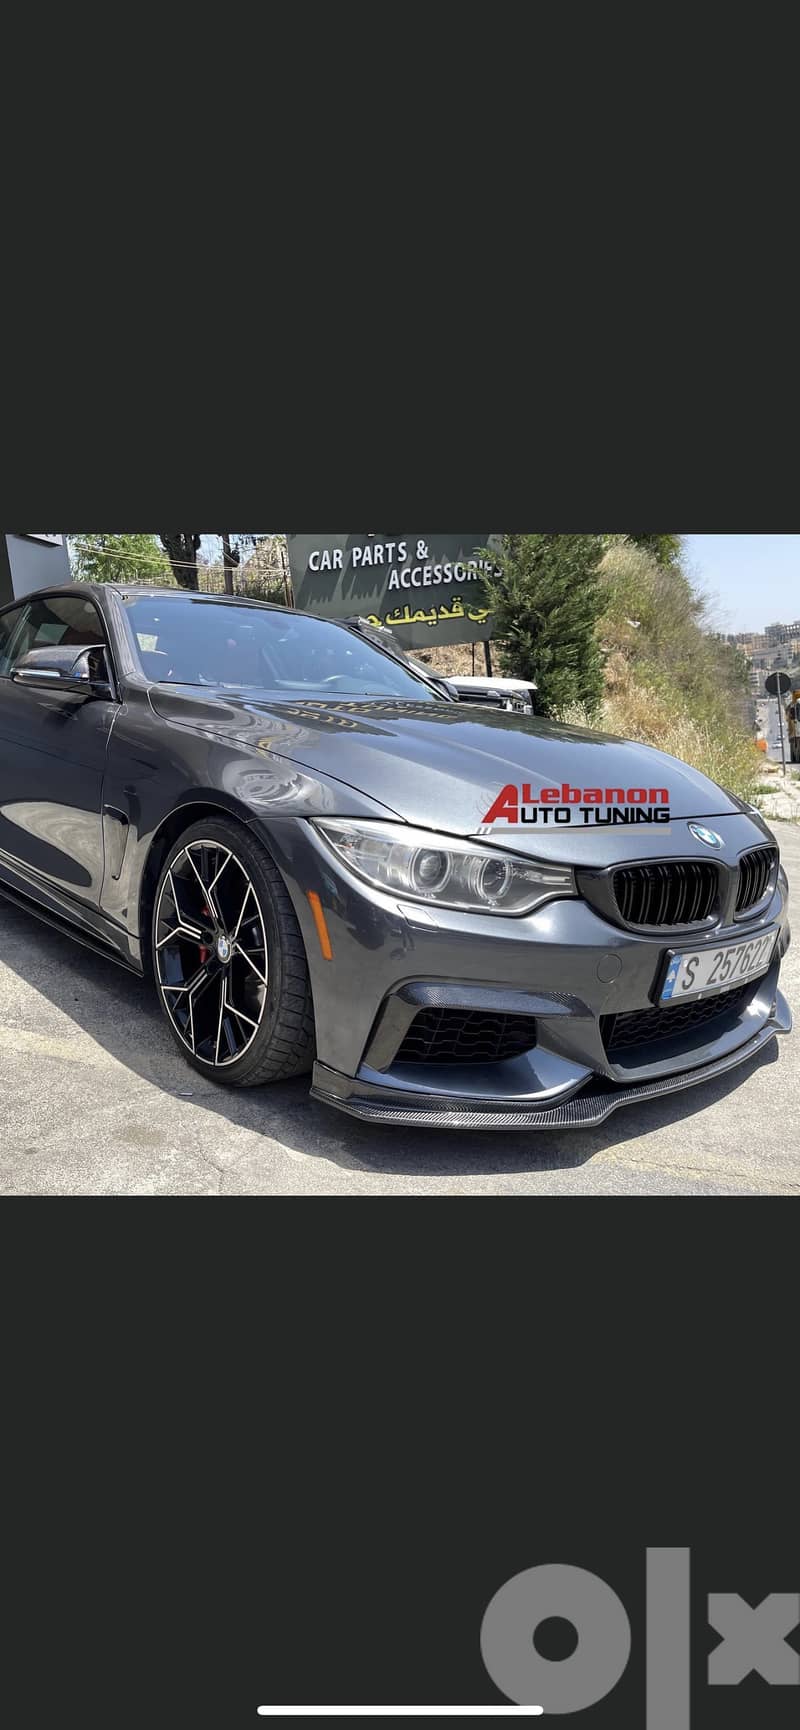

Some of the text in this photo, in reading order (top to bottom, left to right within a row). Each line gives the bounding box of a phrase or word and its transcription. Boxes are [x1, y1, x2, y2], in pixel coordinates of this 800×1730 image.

[308, 539, 429, 571] CAR PARTS &
[682, 956, 700, 990] S
